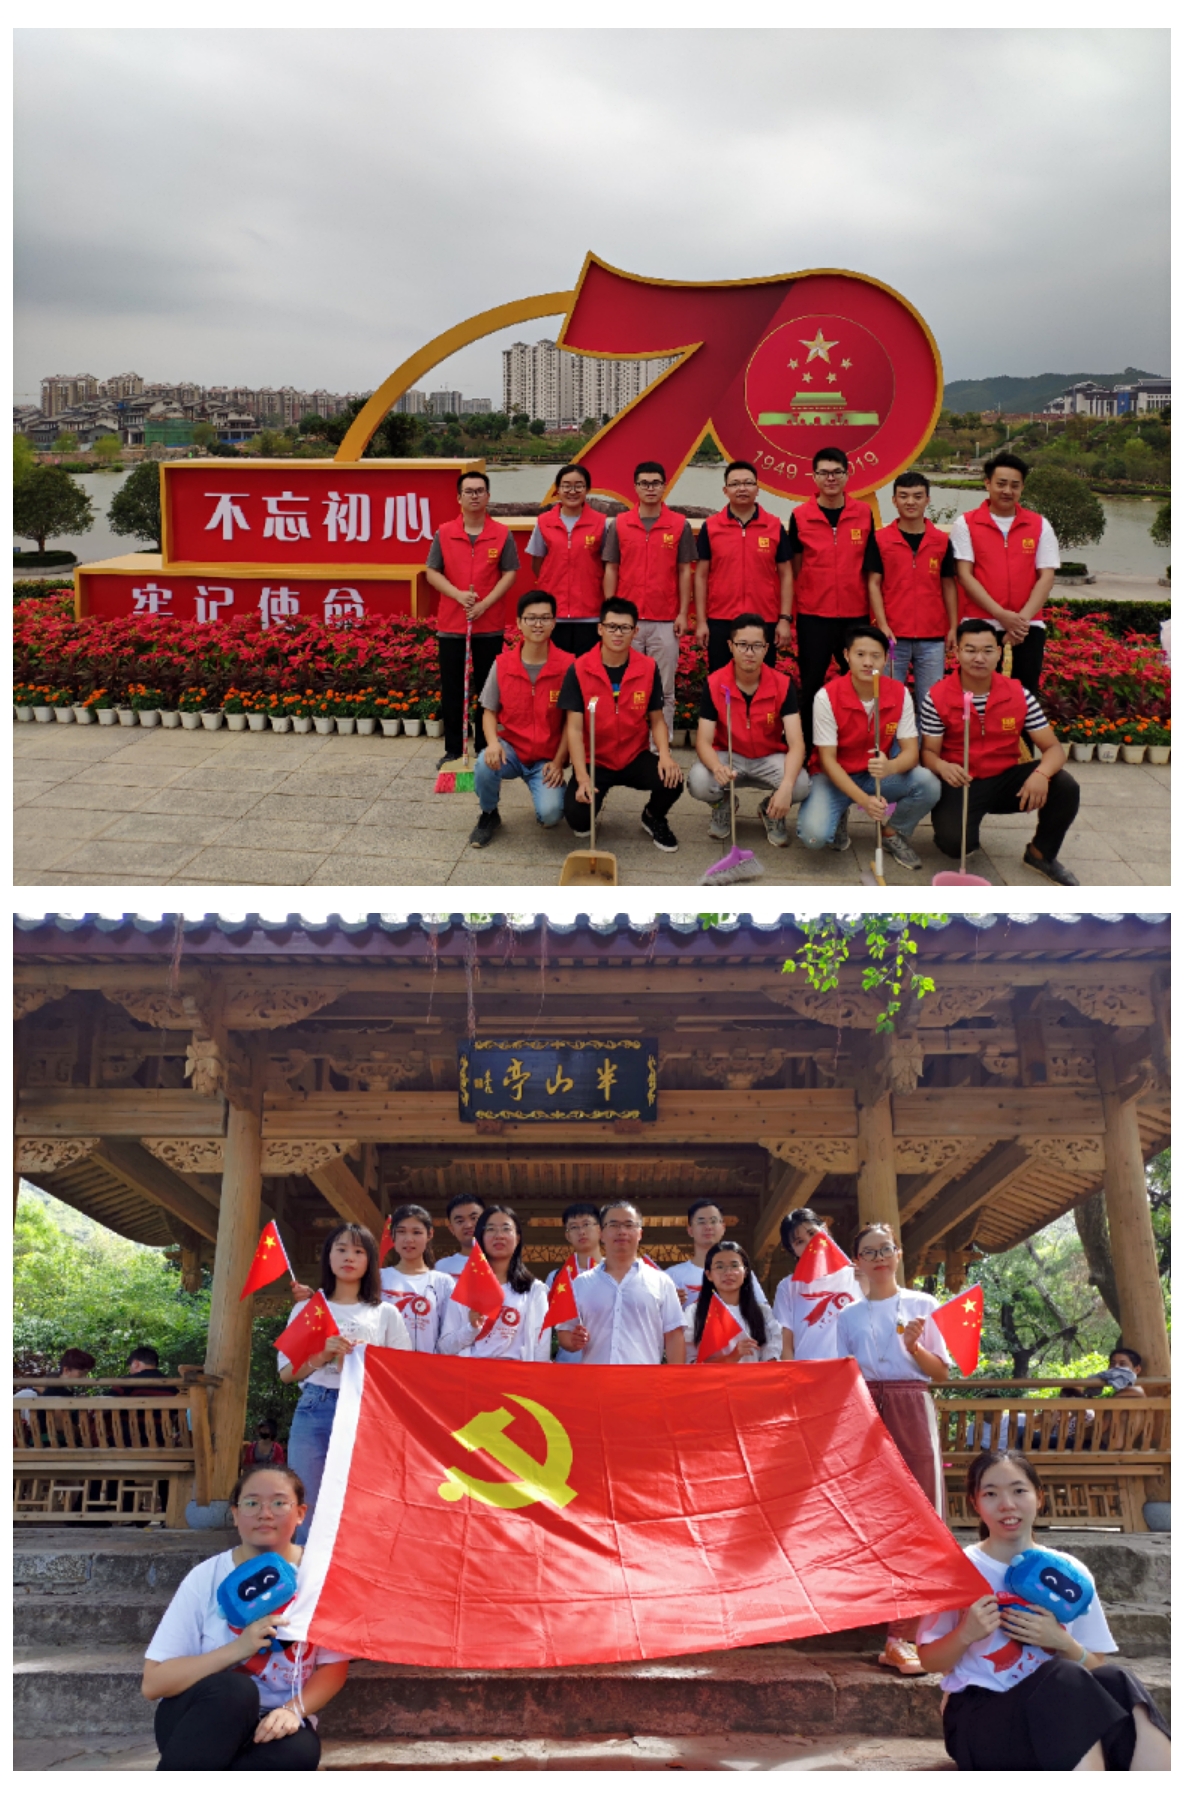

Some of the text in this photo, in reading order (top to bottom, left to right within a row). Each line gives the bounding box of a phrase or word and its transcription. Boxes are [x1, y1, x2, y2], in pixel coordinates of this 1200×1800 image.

[752, 450, 798, 480] 1949
[204, 491, 433, 543] 不忘初心
[132, 583, 365, 630] 牢记使命
